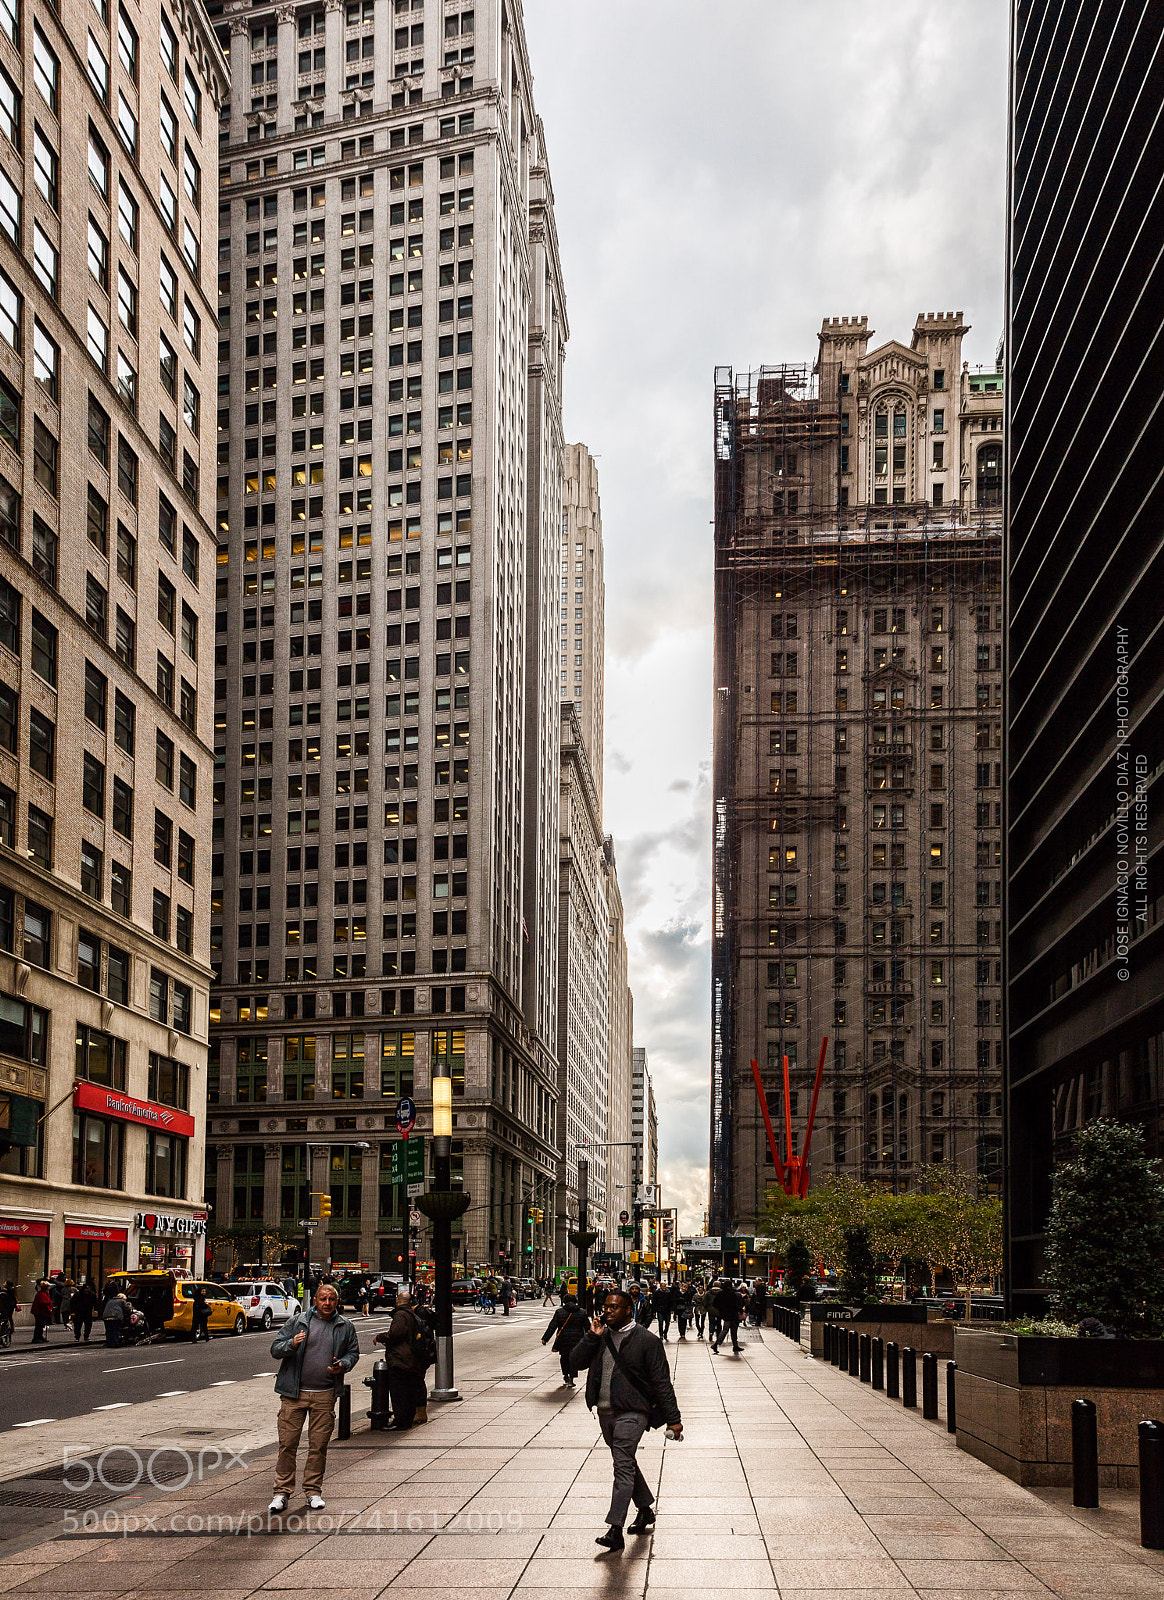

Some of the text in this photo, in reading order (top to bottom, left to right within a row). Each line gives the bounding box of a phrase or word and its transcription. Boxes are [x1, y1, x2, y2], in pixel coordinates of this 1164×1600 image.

[106, 1094, 158, 1121] Bank of America
[176, 1217, 207, 1235] GIFTS
